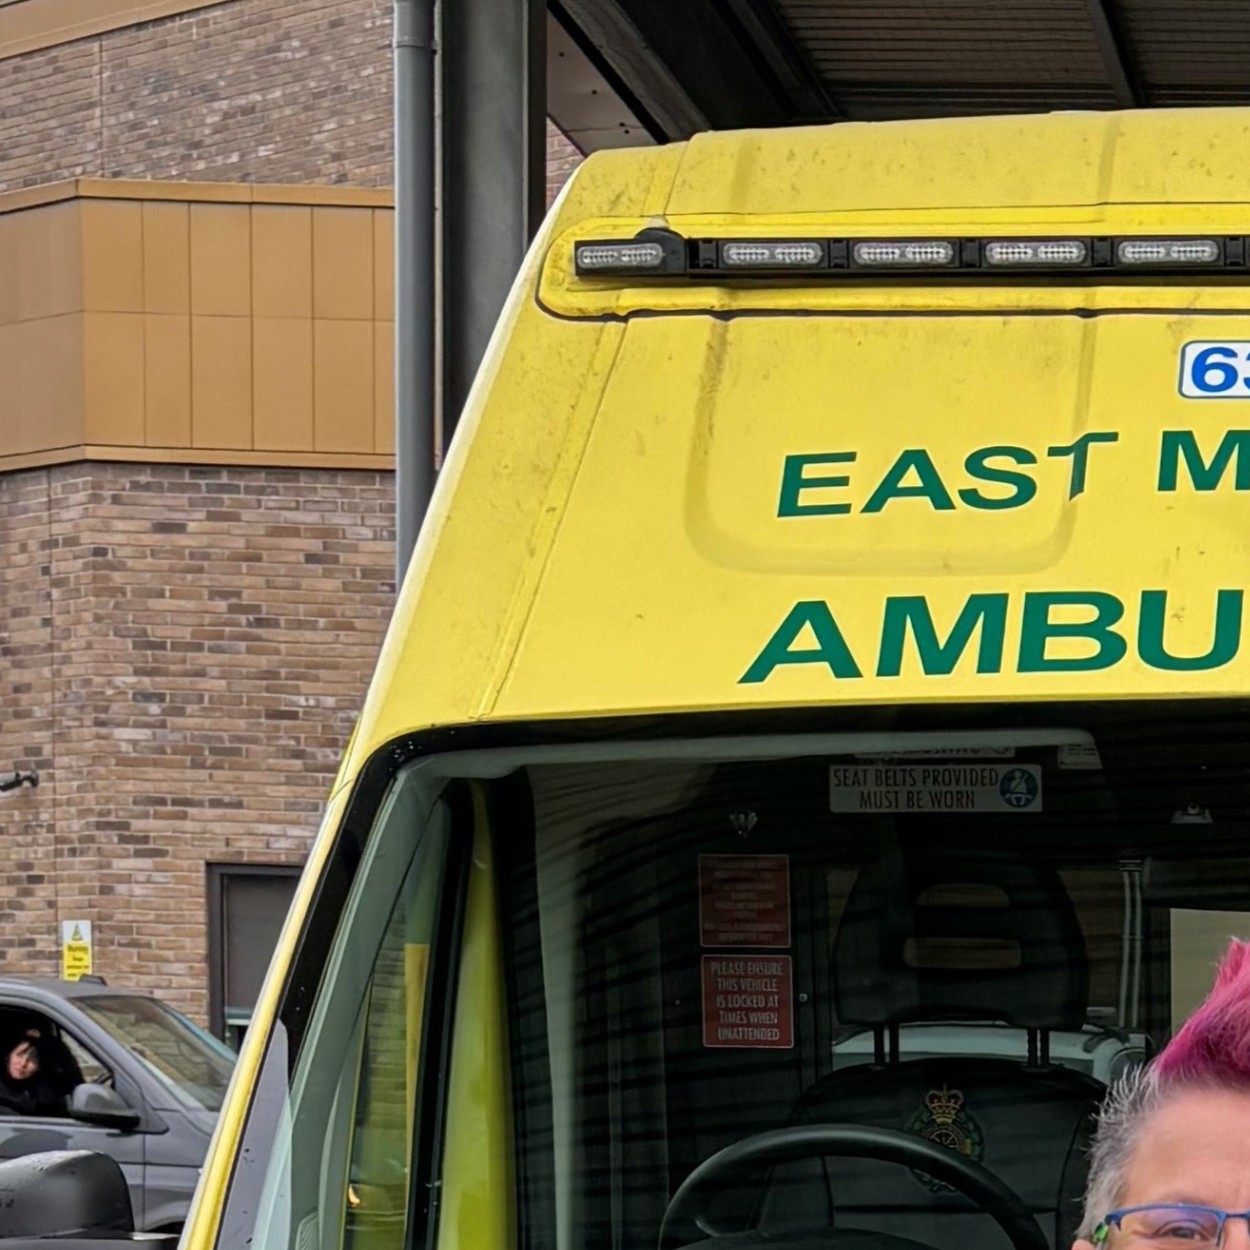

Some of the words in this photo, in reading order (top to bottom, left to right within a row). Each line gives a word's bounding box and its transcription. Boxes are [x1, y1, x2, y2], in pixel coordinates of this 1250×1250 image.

[777, 432, 1120, 518] EAST
[833, 768, 869, 788] SEAT
[875, 768, 917, 788] BELTS
[922, 768, 999, 788] PROVIDED
[859, 790, 899, 810] MUST
[906, 790, 924, 810] BE
[929, 790, 975, 810] WORN
[711, 961, 744, 976] PLEASE
[746, 961, 783, 976] ENSURE
[717, 978, 738, 991] THIS
[740, 978, 779, 992] VEHICLE
[716, 994, 726, 1008] IS
[728, 994, 765, 1008] LOCKED
[719, 1010, 747, 1024] TIMES
[748, 1011, 778, 1024] WHEN
[717, 1027, 780, 1041] UNATTENDED
